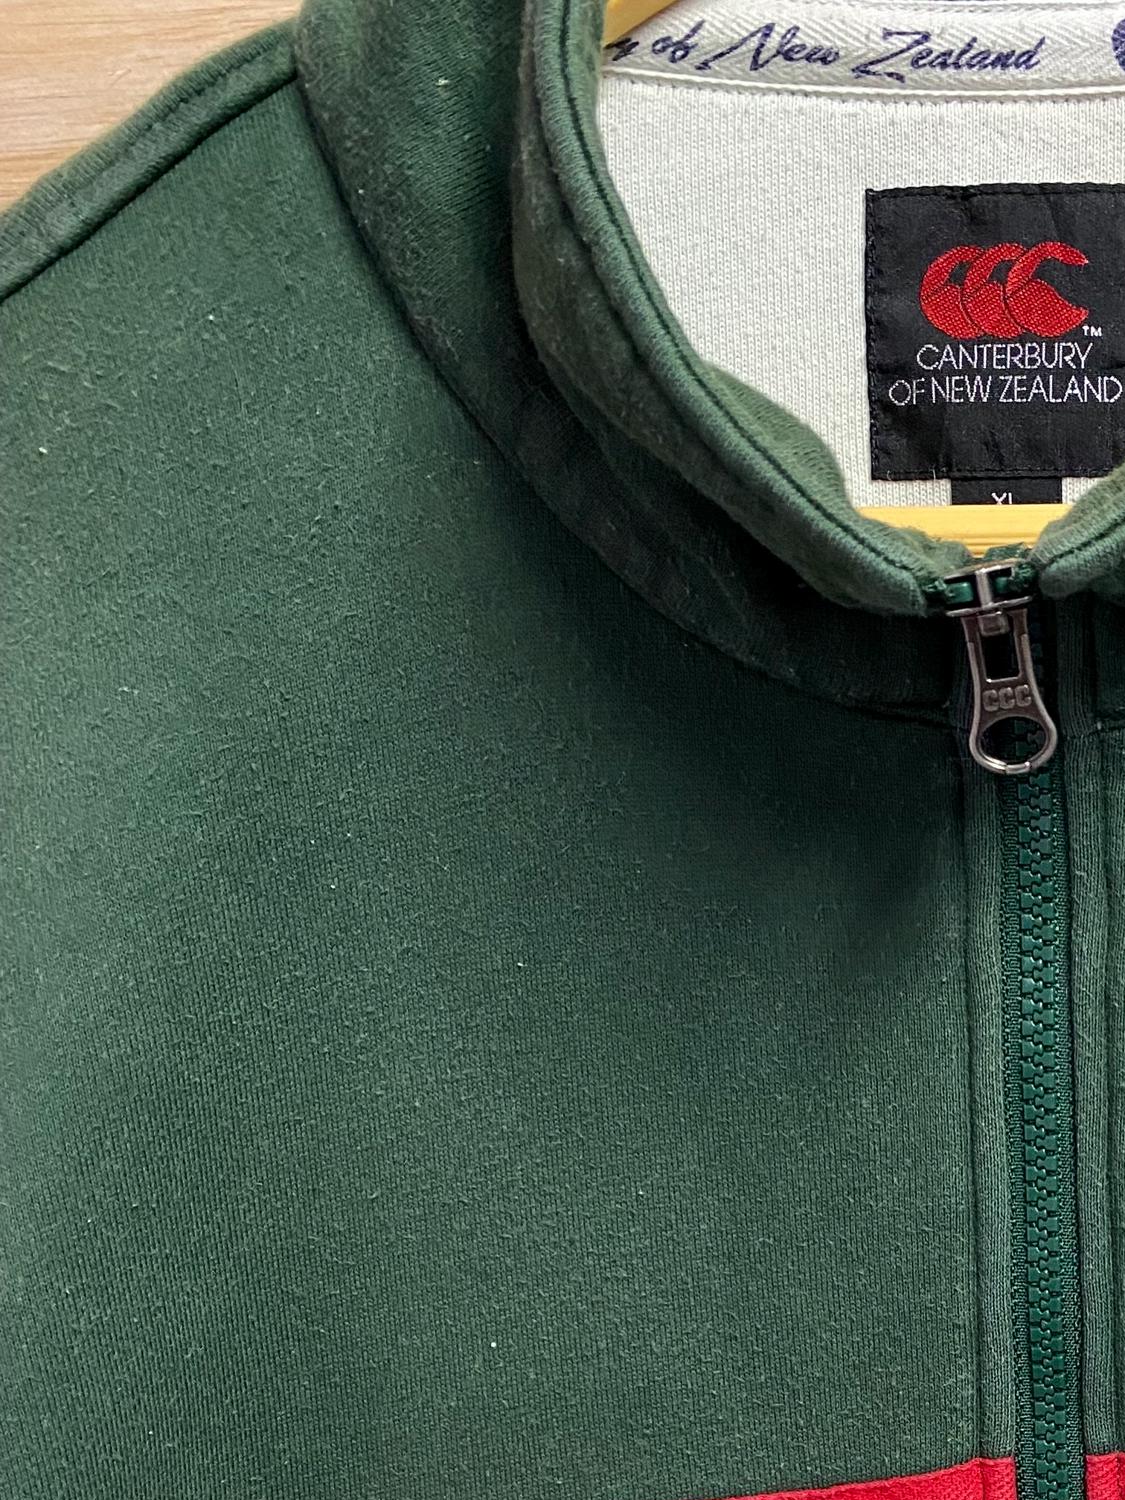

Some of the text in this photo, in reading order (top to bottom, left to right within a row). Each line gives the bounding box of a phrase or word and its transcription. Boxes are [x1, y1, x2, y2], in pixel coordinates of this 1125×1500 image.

[652, 19, 706, 64] of
[695, 22, 839, 71] New
[851, 27, 1045, 83] Zealand
[1082, 325, 1102, 337] TM
[916, 342, 1093, 370] CANTERBURY
[888, 375, 1123, 406] OF NEW ZEALAND
